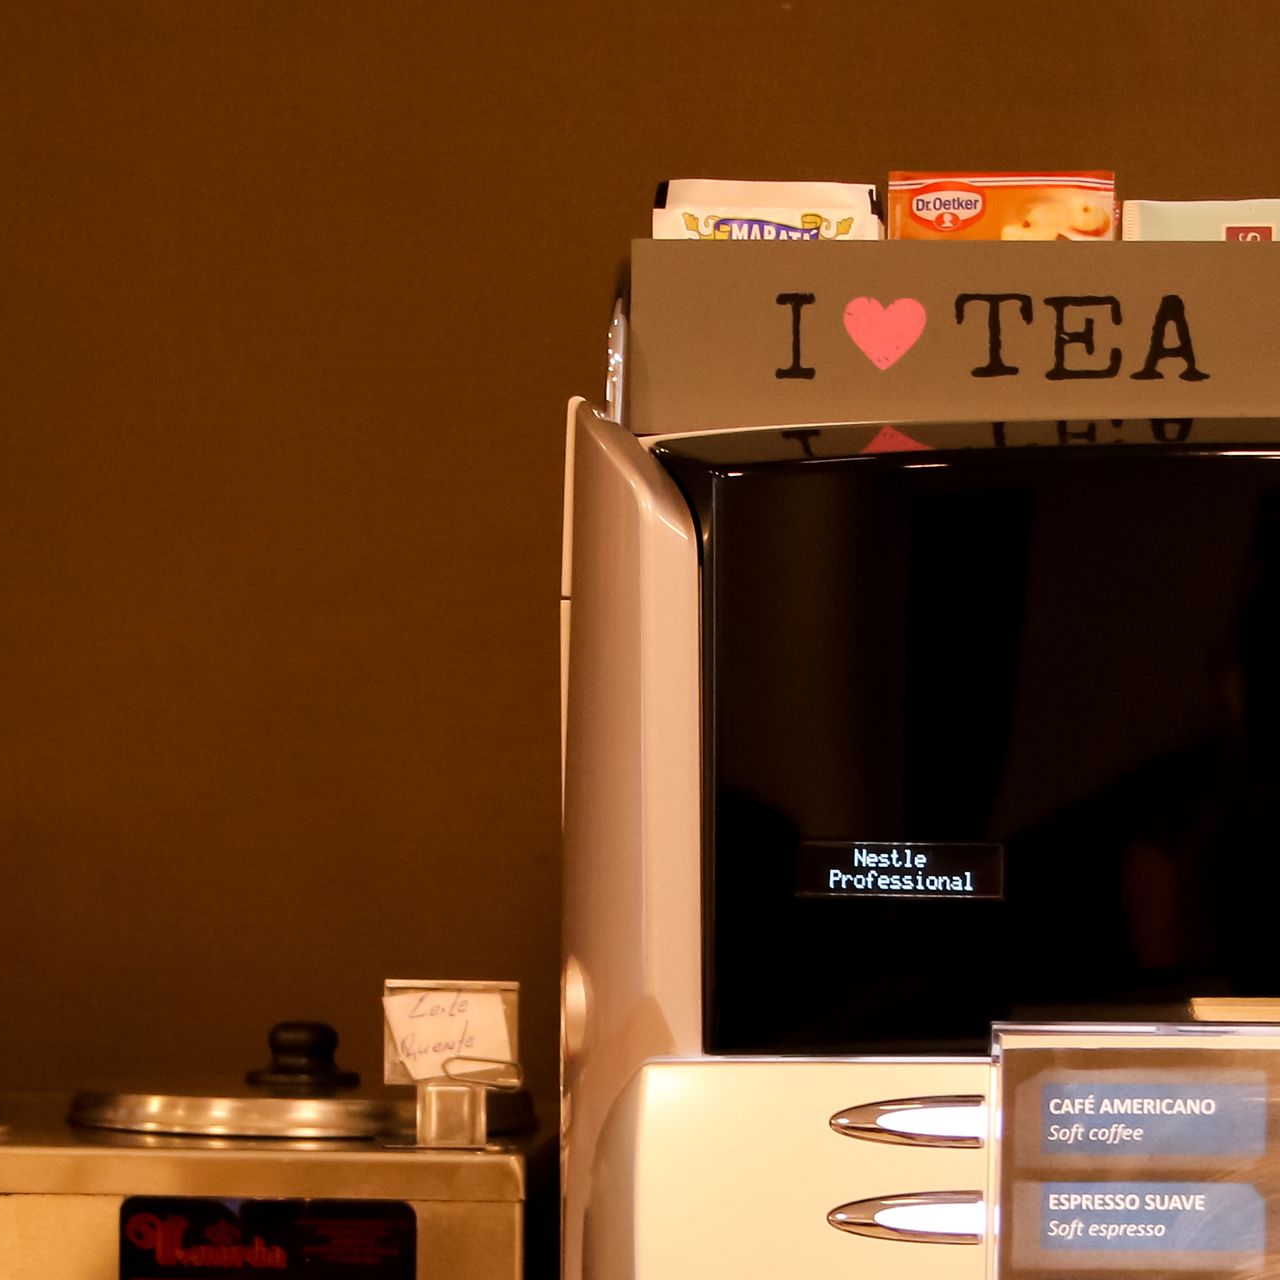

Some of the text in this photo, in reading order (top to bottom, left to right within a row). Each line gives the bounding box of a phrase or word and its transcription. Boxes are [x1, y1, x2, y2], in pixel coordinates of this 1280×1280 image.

[776, 292, 1209, 382] I TEA
[854, 848, 927, 868] Nestle
[829, 869, 973, 891] Professional
[1049, 1095, 1215, 1116] CAFÉ AMERICANO
[1048, 1123, 1144, 1144] Soft coffee
[1049, 1193, 1205, 1211] ESPRESSO SUAVE
[1047, 1218, 1166, 1240] Soft espresso
